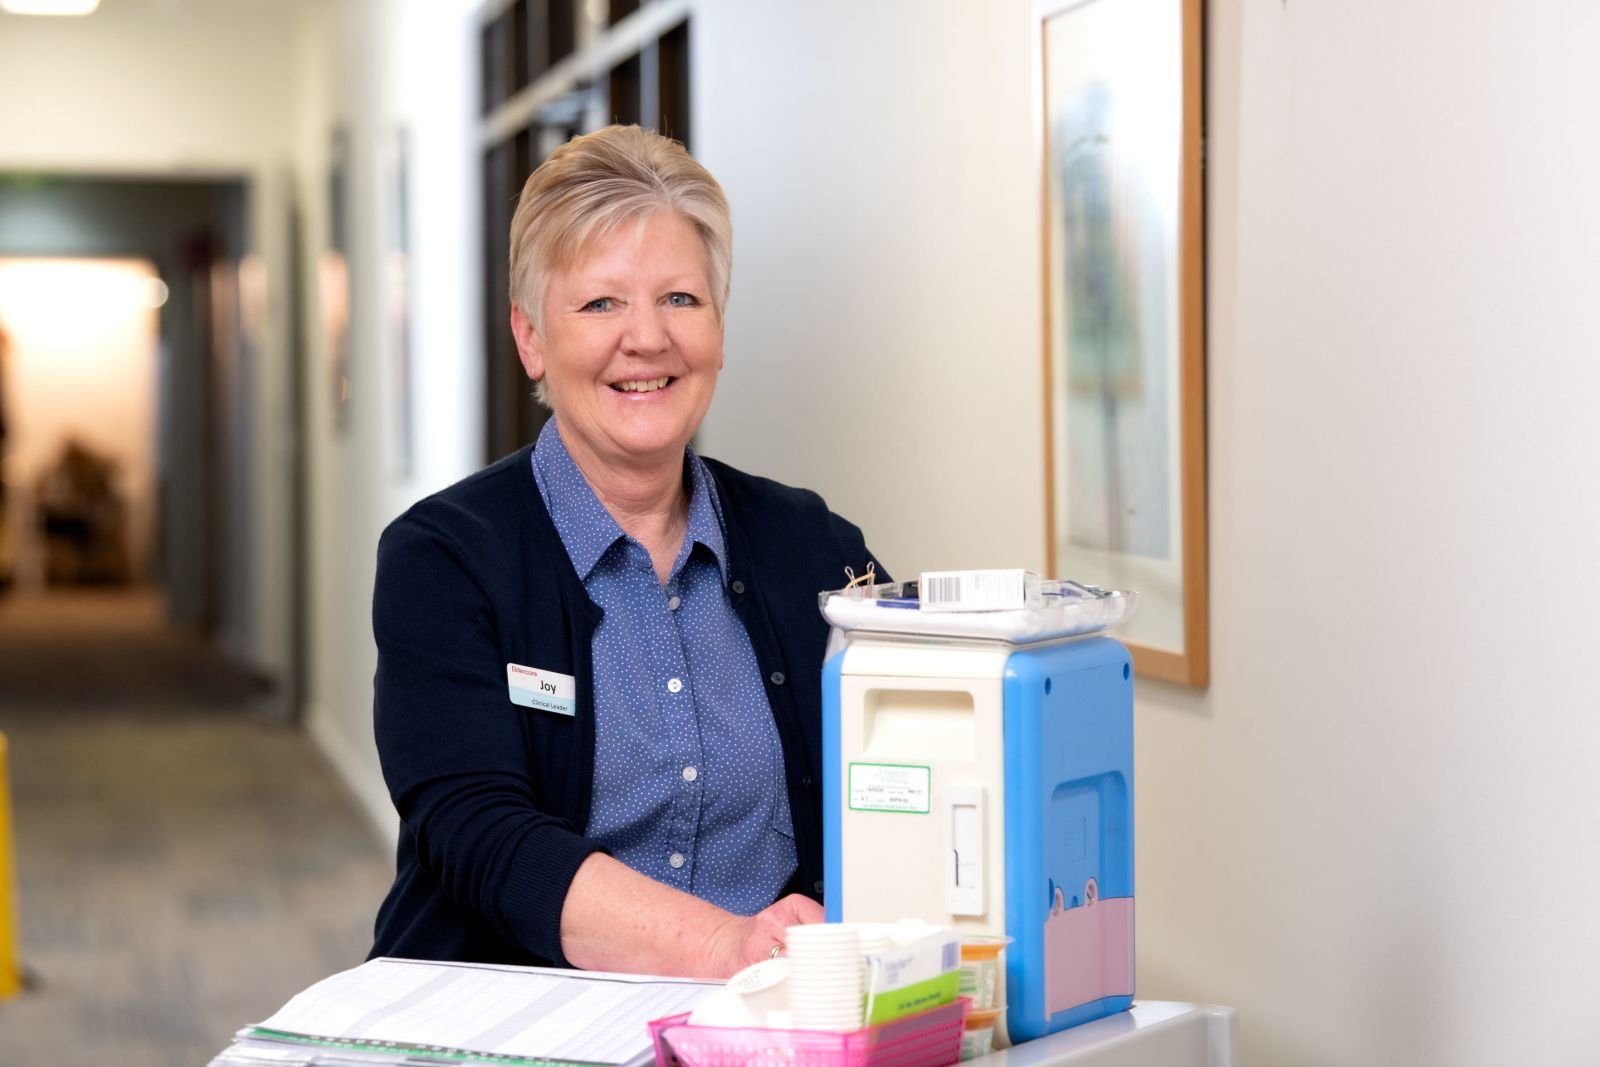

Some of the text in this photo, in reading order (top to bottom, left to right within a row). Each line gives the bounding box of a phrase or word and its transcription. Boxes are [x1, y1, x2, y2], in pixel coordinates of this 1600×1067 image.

[540, 680, 556, 695] Joy
[531, 699, 568, 711] Clinical Leader
